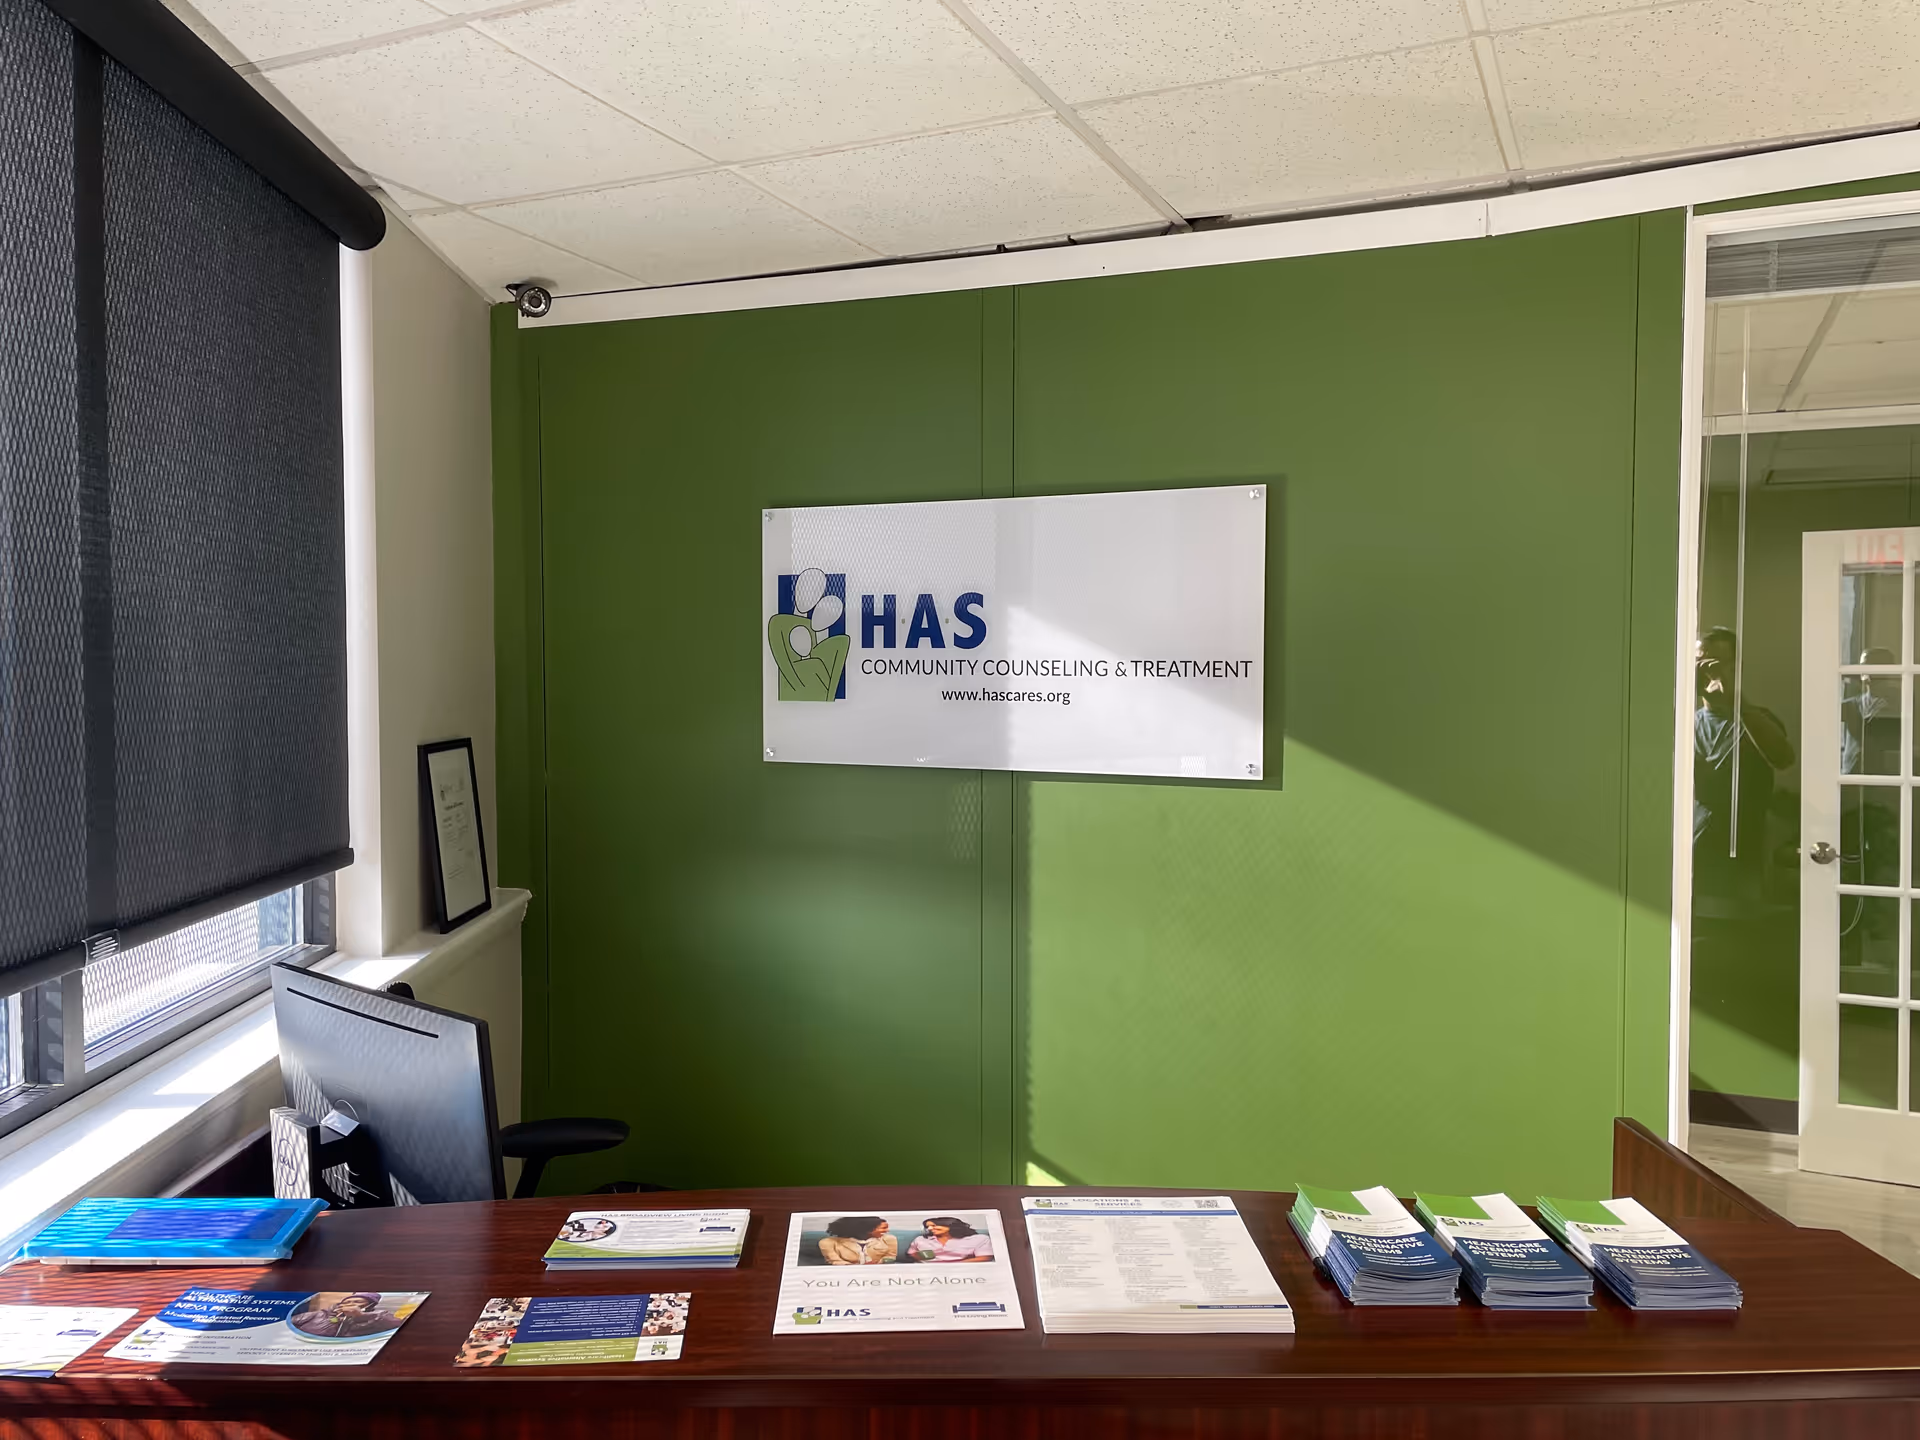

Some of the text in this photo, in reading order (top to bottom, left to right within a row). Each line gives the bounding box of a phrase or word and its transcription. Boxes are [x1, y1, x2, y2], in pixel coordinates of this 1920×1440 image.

[861, 659, 1253, 678] COMMUNITY COUNSELING & TREATMENT
[941, 687, 1071, 706] www.hascares.org
[1341, 1233, 1419, 1243] HEALTHCARE
[1346, 1239, 1425, 1249] ALTERNATIVE
[1349, 1243, 1403, 1254] SYSTEMS
[1463, 1240, 1542, 1248] HEALTHCARE
[1468, 1245, 1549, 1253] ALTERNATIVE
[1471, 1250, 1527, 1258] SYSTEMS
[1611, 1252, 1691, 1260] ALTERNATIVE
[803, 1276, 987, 1288] You Are Not Alone
[189, 1290, 255, 1300] HEALTHCARE
[174, 1302, 208, 1311] NEXA
[826, 1308, 871, 1317] HAS
